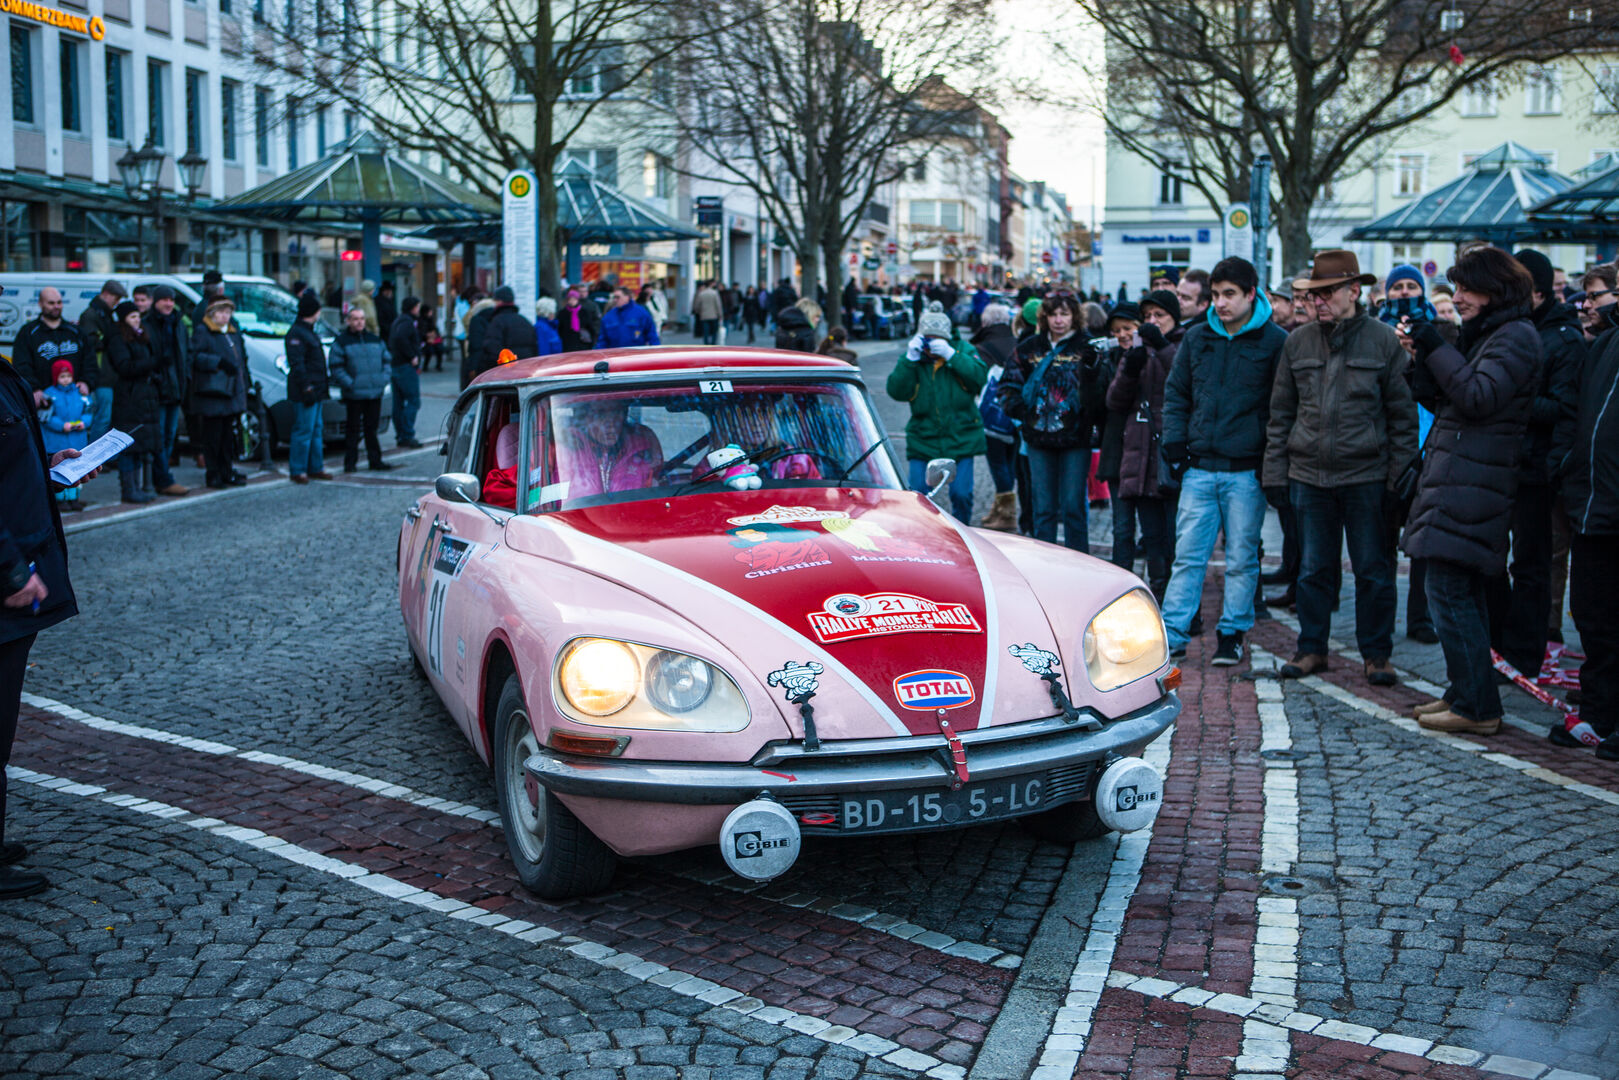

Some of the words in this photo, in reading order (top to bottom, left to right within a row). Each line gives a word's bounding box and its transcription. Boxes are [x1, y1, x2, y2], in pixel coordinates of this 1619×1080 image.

[0, 0, 88, 34] OMMERZBANK
[709, 381, 724, 392] 21
[744, 560, 833, 579] Christina
[878, 599, 906, 611] 21
[815, 615, 870, 636] RALLYE
[872, 606, 972, 628] MONTE-CARLO
[868, 623, 936, 634] HISTORIQUE
[901, 681, 968, 699] TOTAL
[1124, 792, 1157, 804] CIBIE
[744, 838, 789, 851] CIBIE
